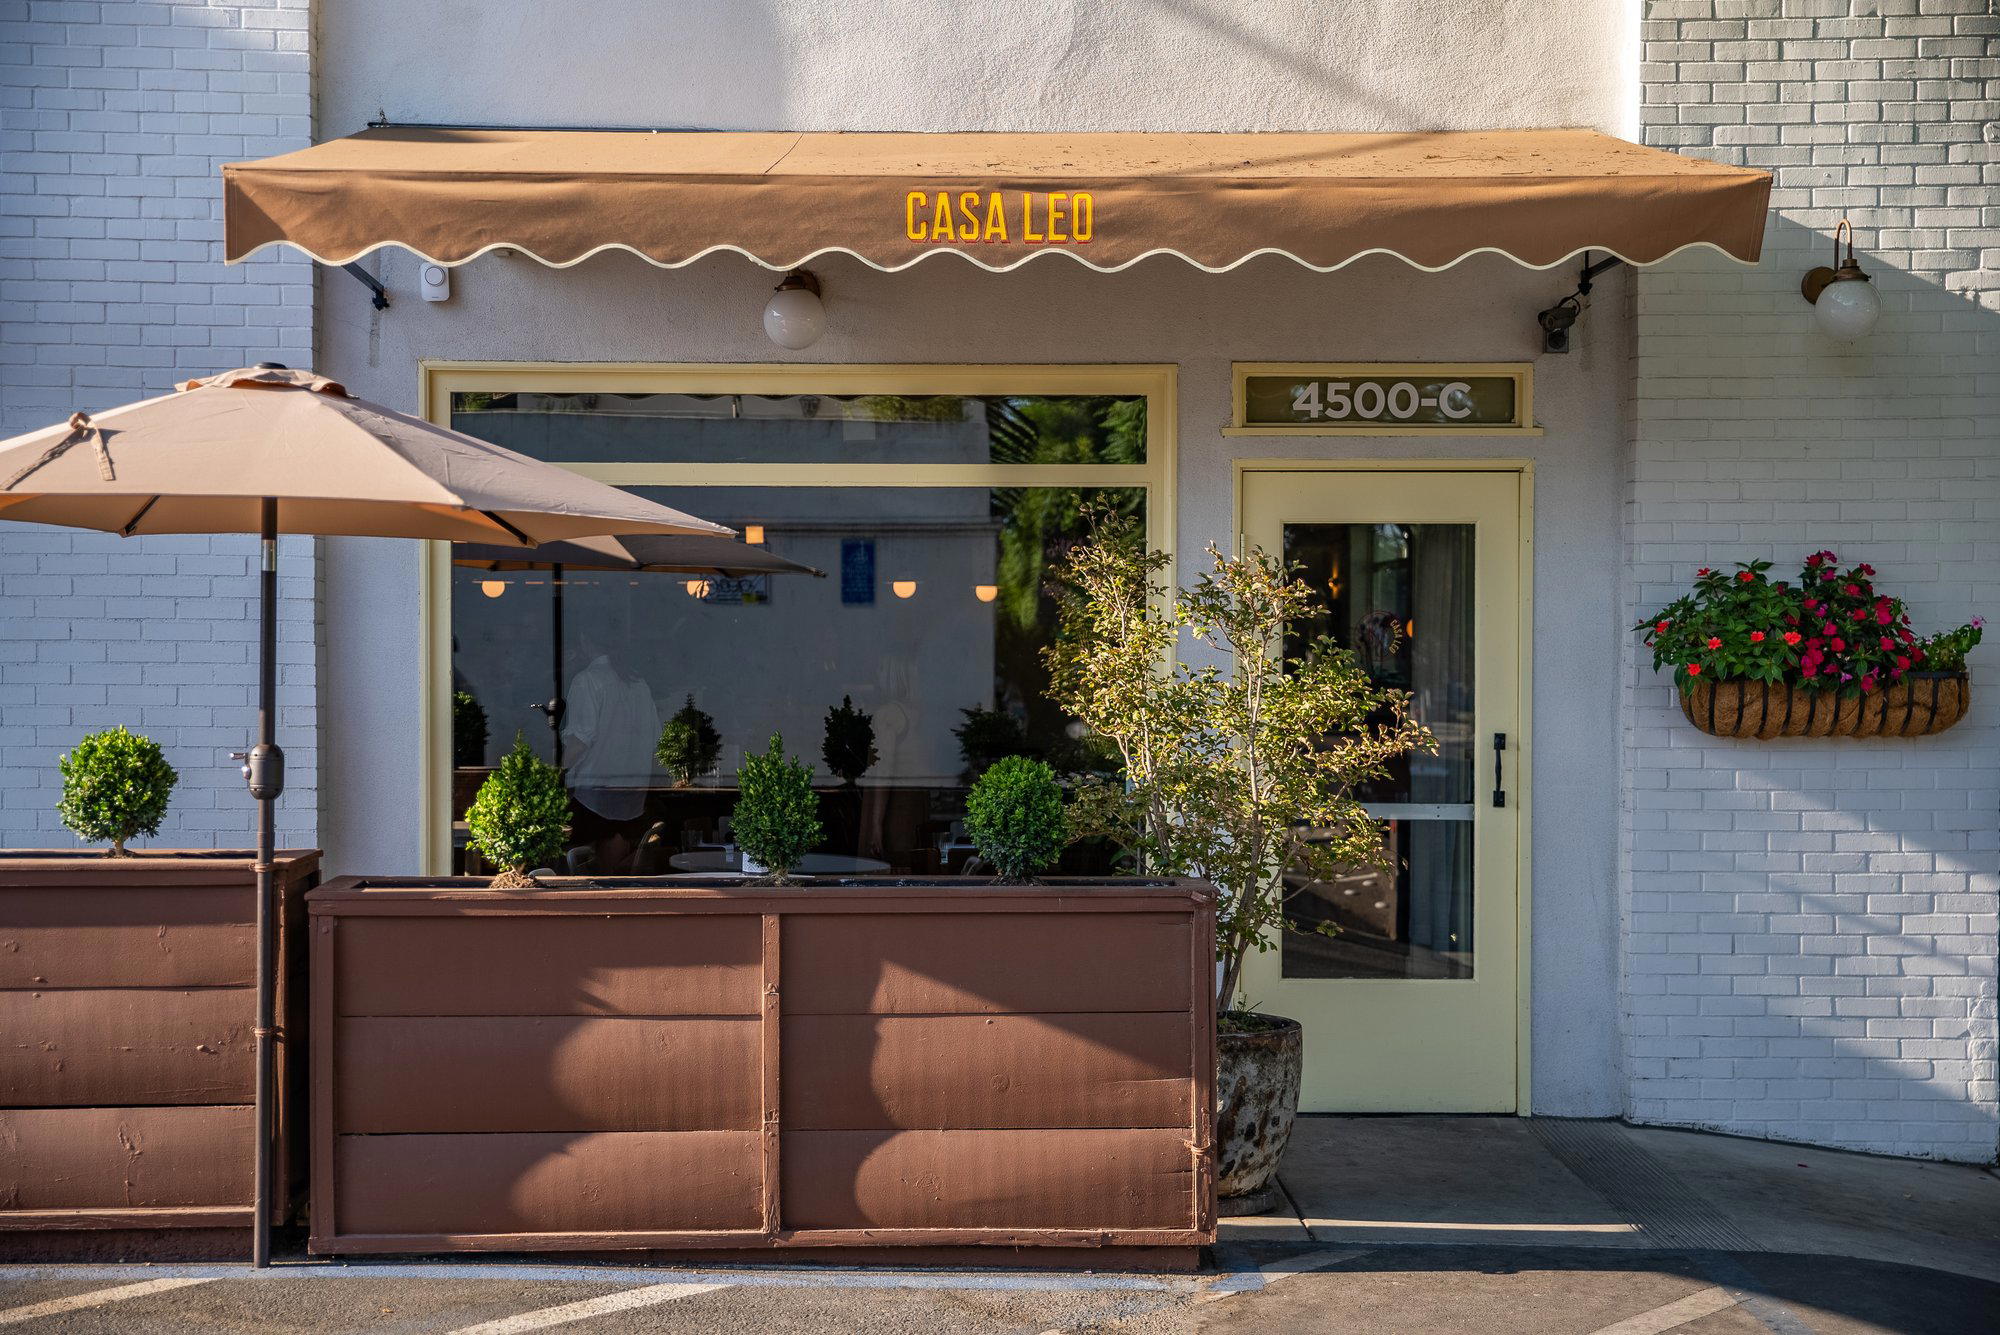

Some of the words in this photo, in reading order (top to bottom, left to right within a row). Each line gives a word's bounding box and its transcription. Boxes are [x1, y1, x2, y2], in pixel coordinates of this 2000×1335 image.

[906, 191, 1010, 243] CASA
[1023, 192, 1094, 243] LEO
[1292, 382, 1472, 419] 4500-C
[1390, 619, 1403, 638] CASA
[1388, 640, 1402, 654] LEO
